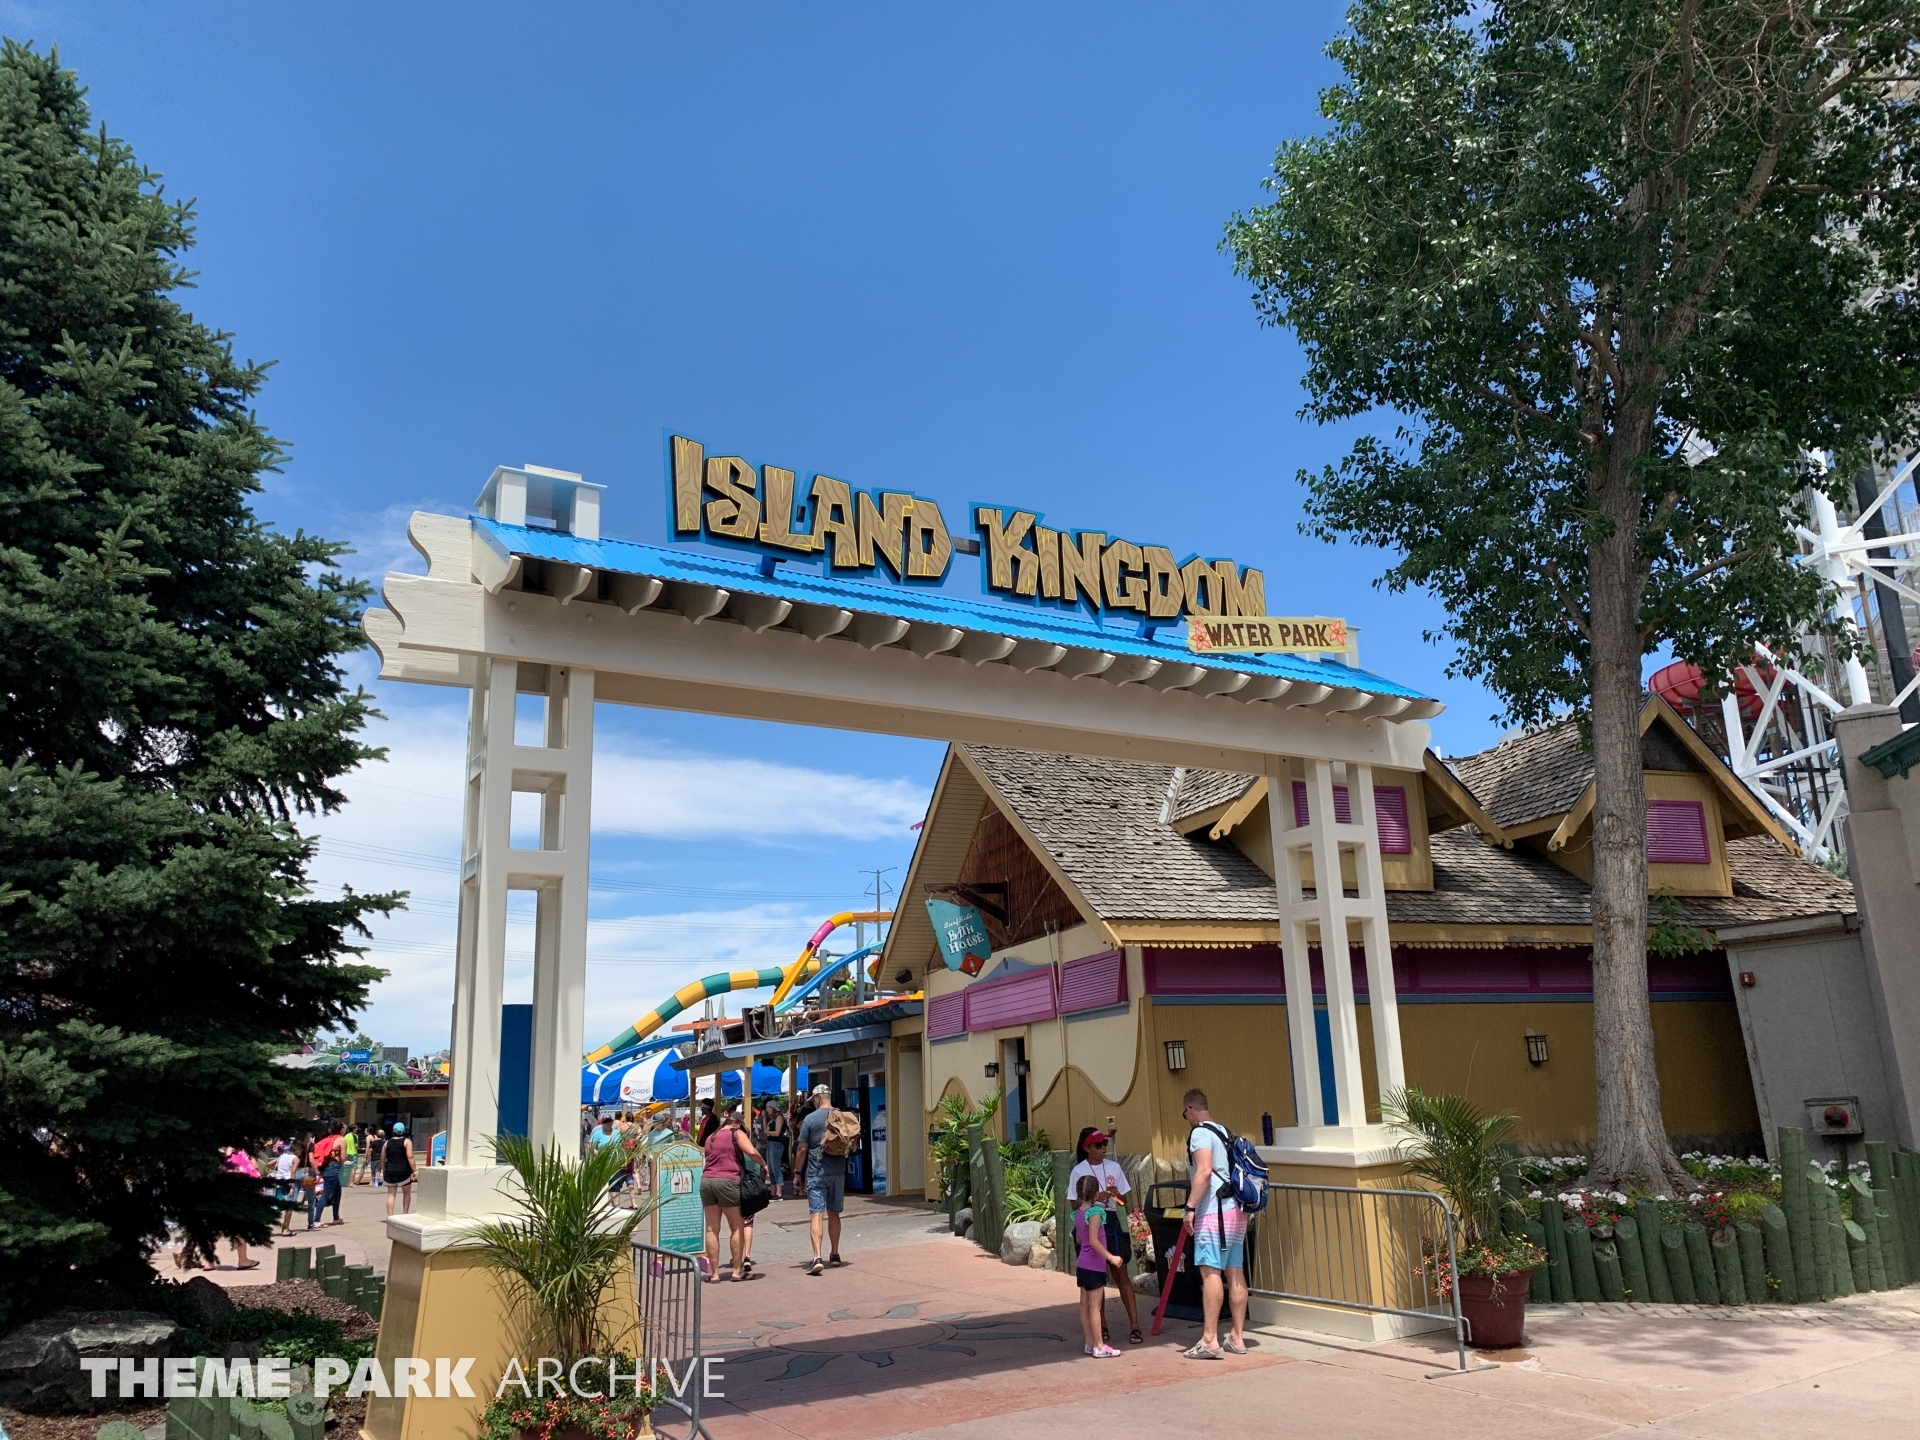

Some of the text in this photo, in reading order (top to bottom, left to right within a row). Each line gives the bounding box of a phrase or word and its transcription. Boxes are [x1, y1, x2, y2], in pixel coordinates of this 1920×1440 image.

[670, 433, 1266, 620] ISLAND KINGDOM
[1204, 622, 1332, 648] WATER PARK
[947, 925, 974, 943] BATH
[947, 932, 984, 954] HOUSE
[350, 1052, 368, 1060] pepsi
[631, 1086, 651, 1096] pepsi
